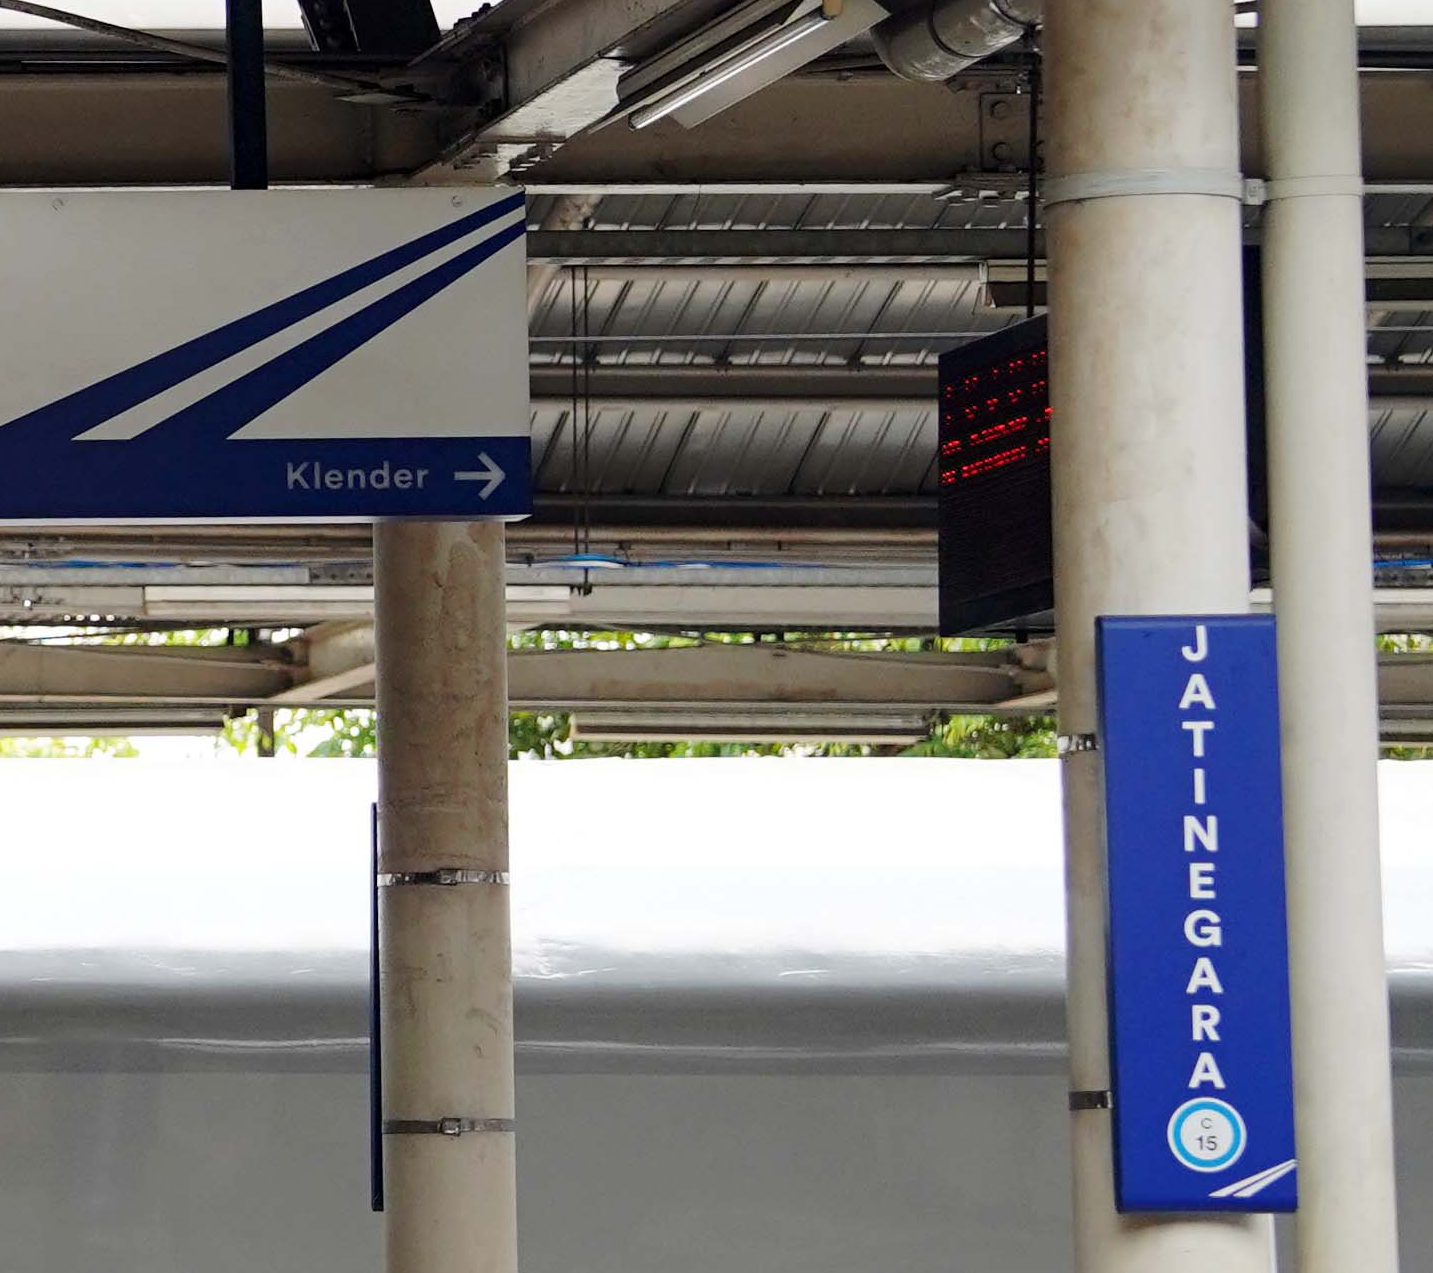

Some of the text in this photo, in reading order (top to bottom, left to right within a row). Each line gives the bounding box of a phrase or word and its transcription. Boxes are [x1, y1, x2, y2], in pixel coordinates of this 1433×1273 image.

[286, 460, 430, 490] Klender
[1179, 625, 1225, 1089] JATINEGARA
[1200, 1117, 1214, 1130] C
[1195, 1135, 1219, 1152] 15
